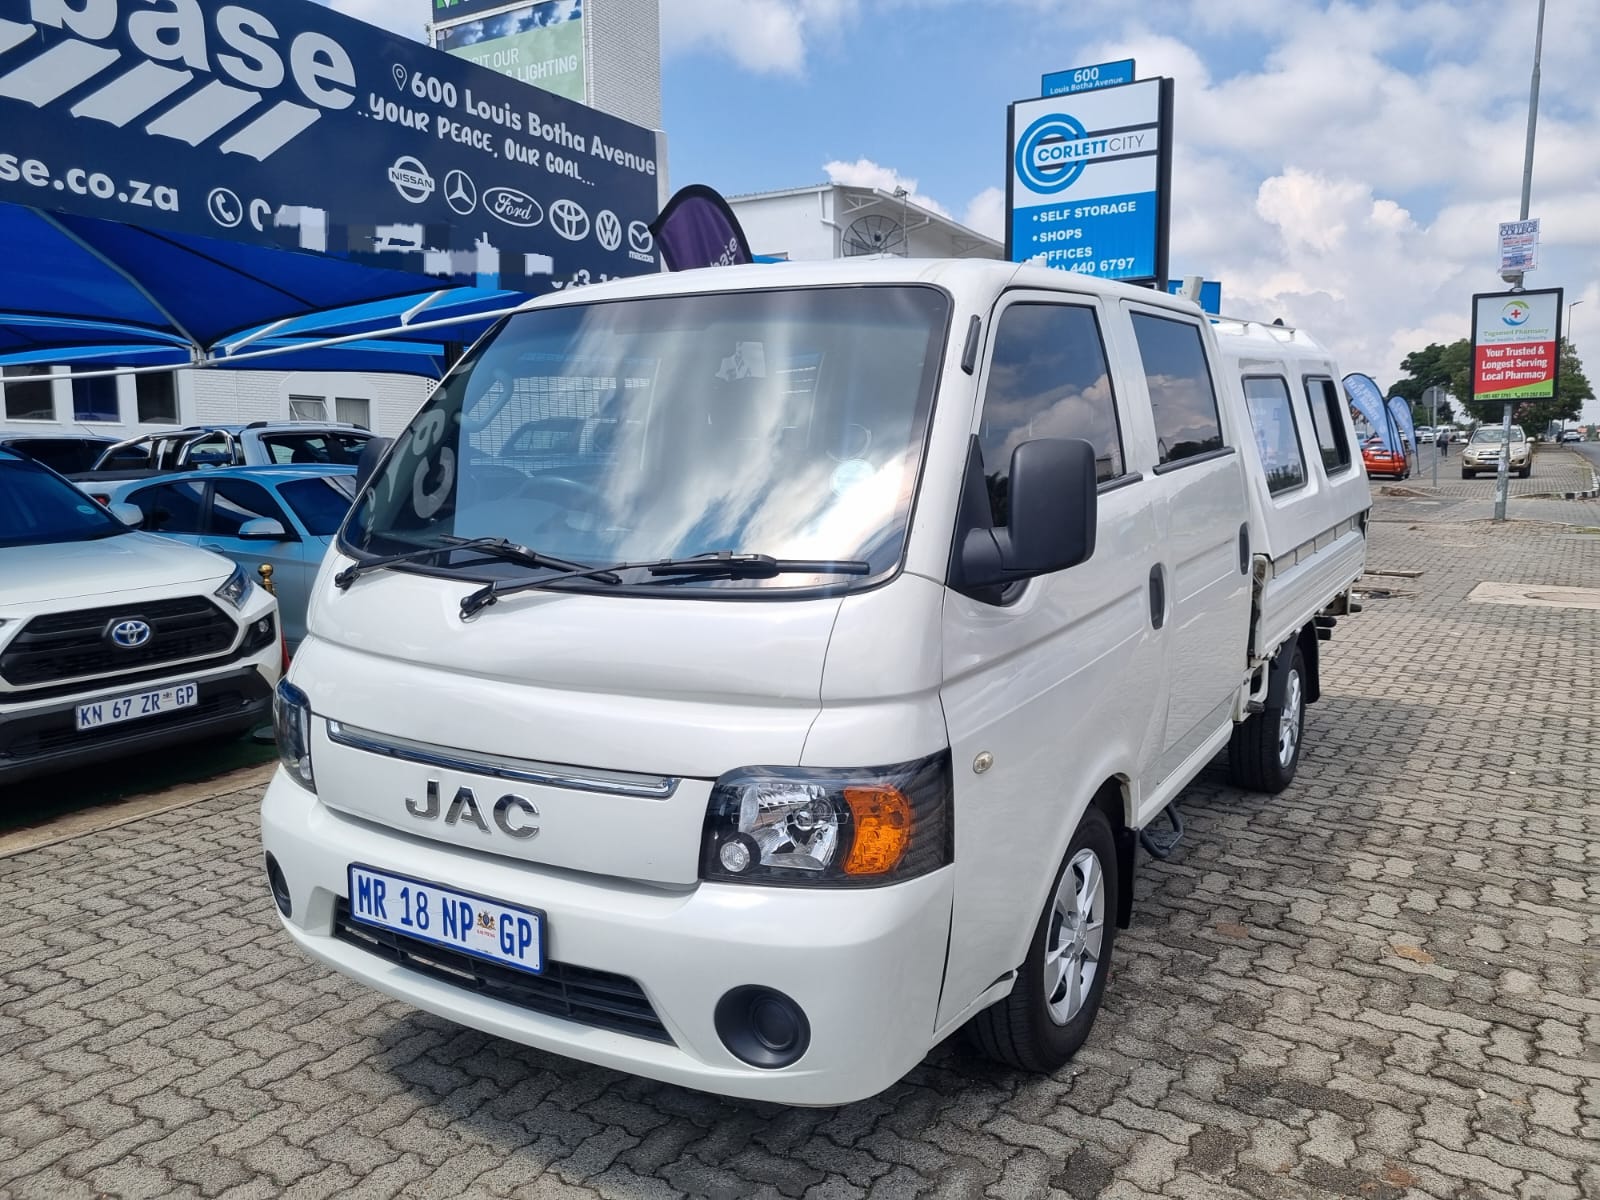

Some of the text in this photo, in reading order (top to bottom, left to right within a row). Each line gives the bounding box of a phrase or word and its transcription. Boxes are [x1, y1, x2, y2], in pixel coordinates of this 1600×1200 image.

[494, 48, 520, 68] OUR
[518, 55, 577, 82] LIGHTING
[1073, 66, 1099, 83] 600
[1050, 77, 1123, 95] Louis Botha Avenue
[411, 71, 656, 176] 600 Louis Botha Avenue
[437, 115, 498, 158] PEACE,
[505, 138, 540, 167] OUR
[391, 170, 433, 189] NISSAN
[494, 192, 532, 220] Ford
[1040, 201, 1136, 222] SELF STORAGE
[1040, 228, 1082, 242] SHOPS
[1070, 261, 1095, 273] 440
[1100, 257, 1135, 272] 6797
[1486, 345, 1545, 358] Your Trusted &
[1482, 358, 1548, 370] Longest Serving
[1482, 370, 1547, 381] Local Pharmacy
[81, 686, 194, 726] KN 67 ZR GP
[405, 779, 540, 840] JAC
[358, 875, 533, 960] MR 18 NP GP
